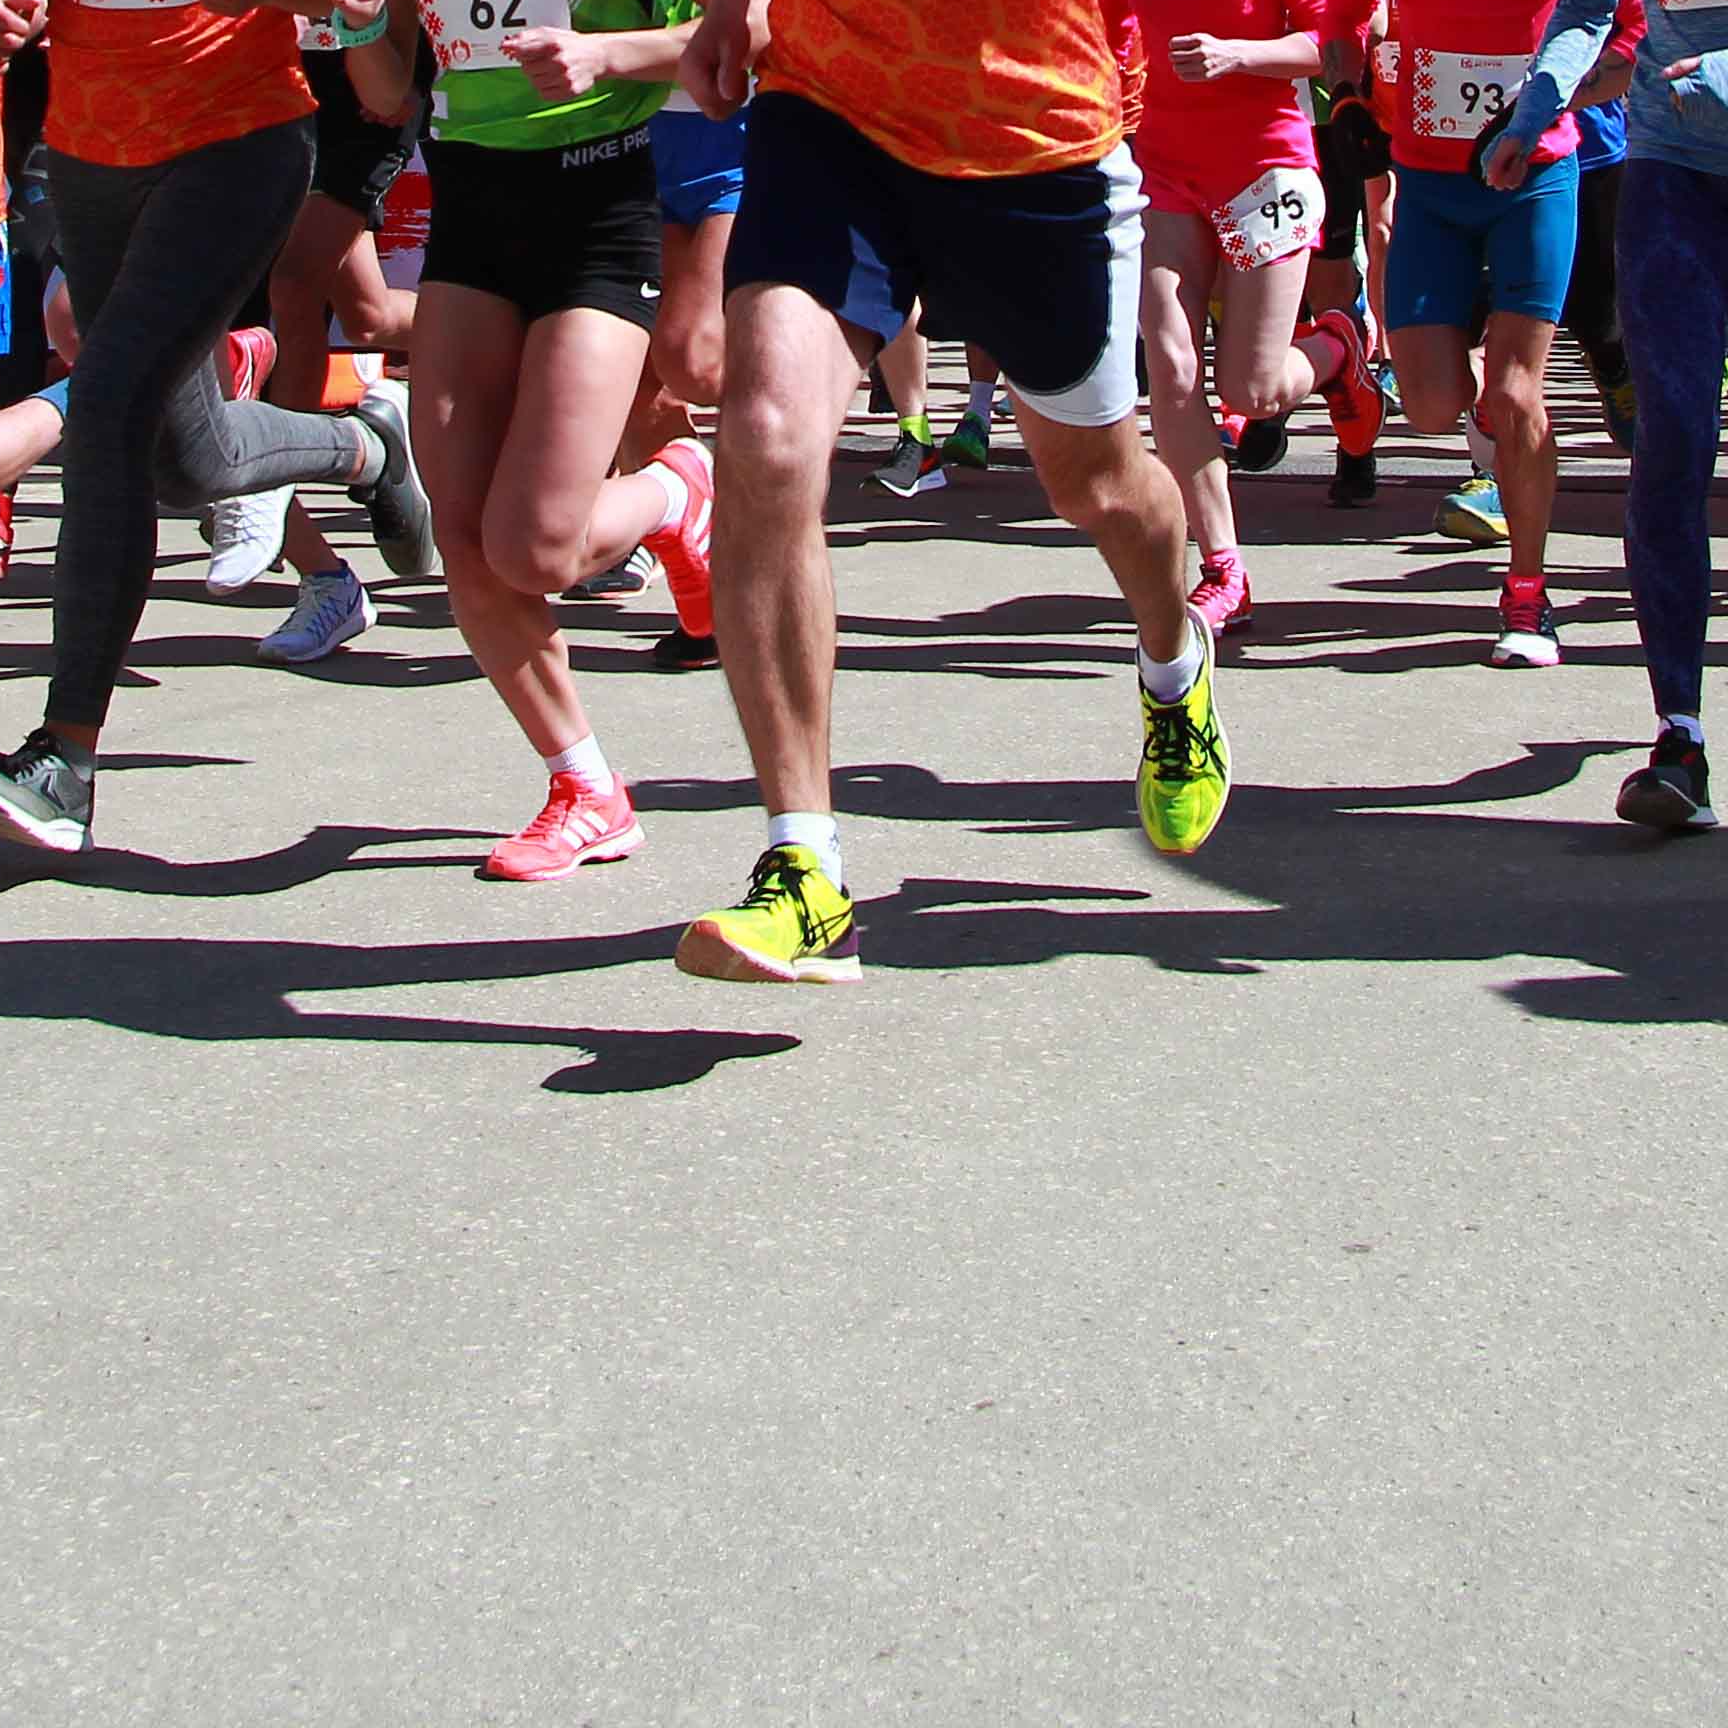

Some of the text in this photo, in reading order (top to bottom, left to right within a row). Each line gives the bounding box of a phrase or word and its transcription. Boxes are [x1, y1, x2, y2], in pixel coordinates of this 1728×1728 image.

[1459, 81, 1505, 115] 93
[562, 138, 619, 169] NIKE
[1260, 189, 1305, 230] 95
